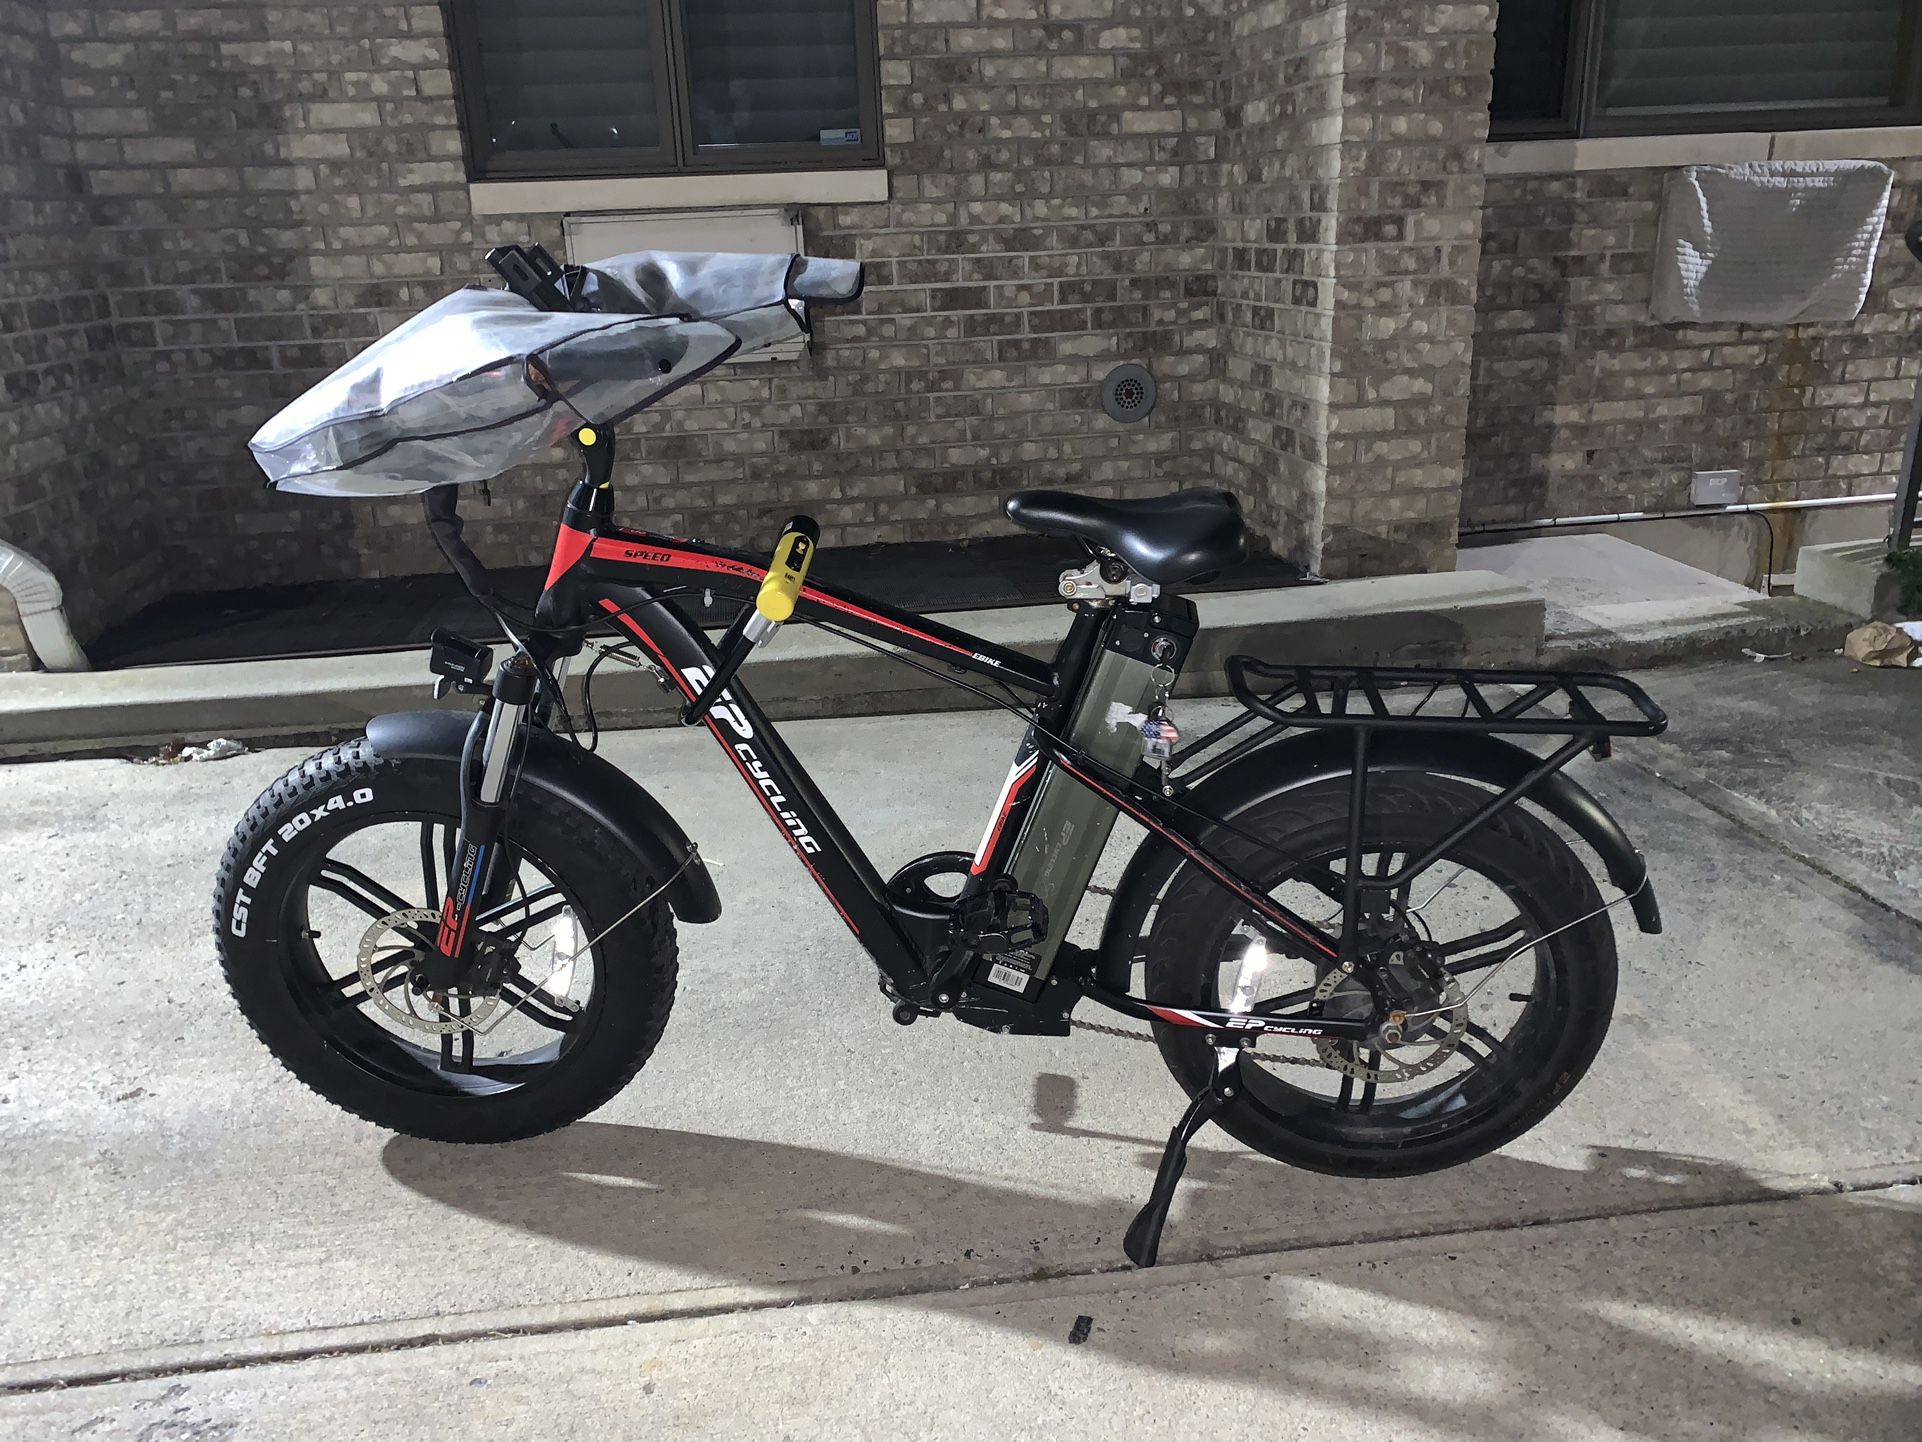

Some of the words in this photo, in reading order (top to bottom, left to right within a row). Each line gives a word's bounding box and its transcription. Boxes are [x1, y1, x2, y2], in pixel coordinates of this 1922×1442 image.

[623, 549, 672, 563] SPEED
[972, 652, 1001, 667] EBIKE
[231, 888, 252, 938] CST
[243, 838, 278, 889] BFT
[1225, 1018, 1266, 1030] EP
